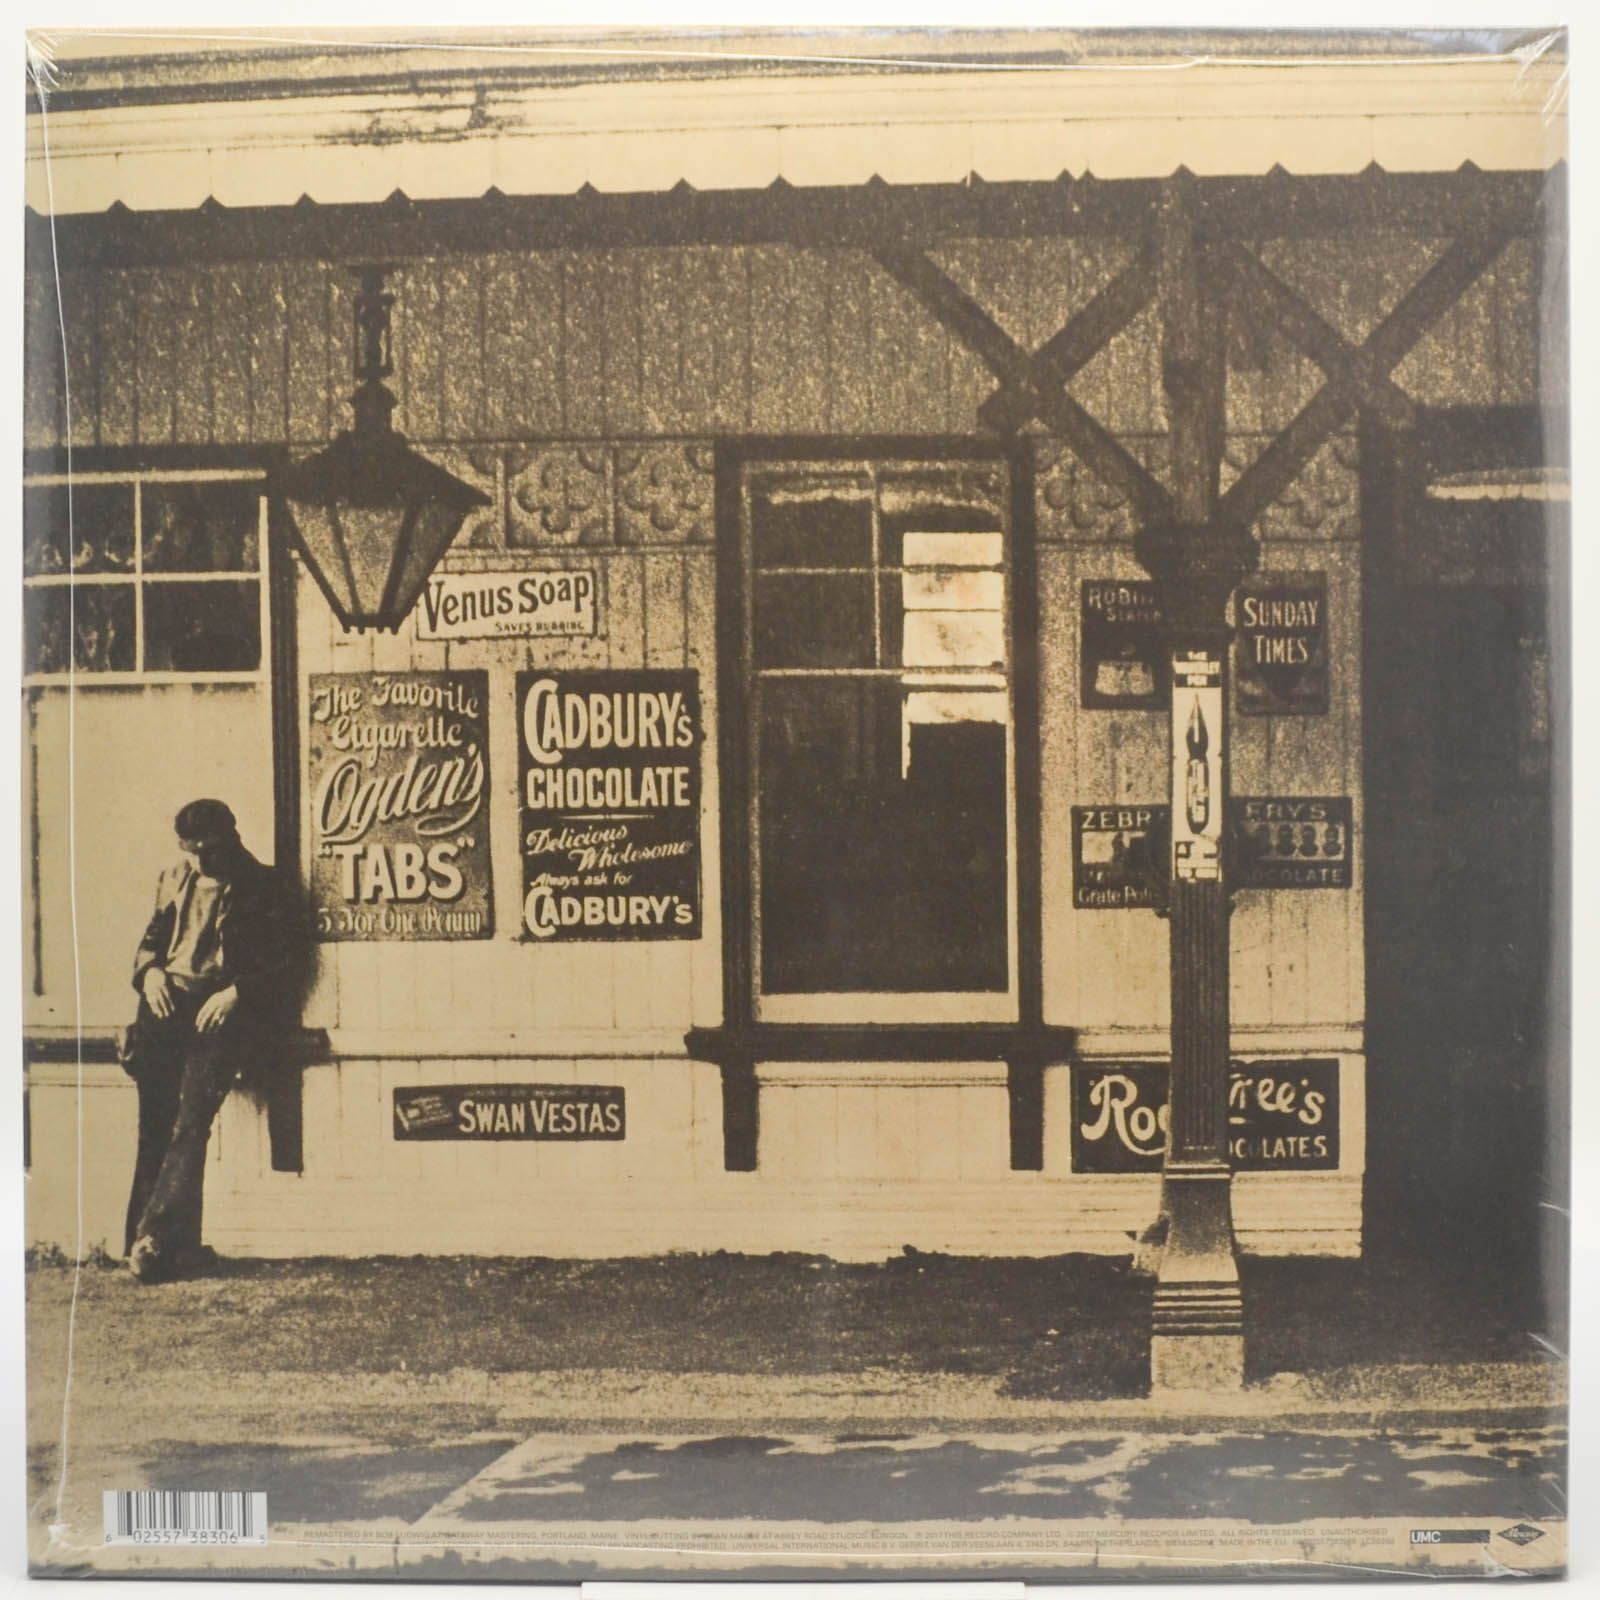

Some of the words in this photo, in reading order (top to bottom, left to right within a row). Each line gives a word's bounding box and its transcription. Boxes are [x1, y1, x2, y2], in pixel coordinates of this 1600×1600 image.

[425, 577, 513, 632] Venus
[518, 574, 591, 614] Soap
[1243, 597, 1318, 628] SUNDAY
[1255, 635, 1309, 664] TIMES
[314, 684, 362, 720] The
[331, 716, 463, 767] Cigarette
[320, 743, 485, 844] Ogden's
[526, 767, 691, 809] CHOCOLATE
[1081, 811, 1152, 829] ZEBR
[526, 825, 628, 856] Delicious
[568, 842, 693, 872] Wholesome
[530, 872, 579, 889] Always
[583, 873, 608, 886] ask
[613, 872, 632, 886] for
[458, 1099, 526, 1133] SWAN
[531, 1099, 622, 1133] VESTAS
[133, 1530, 181, 1544] 02557
[189, 1530, 238, 1545] 38306
[1411, 1530, 1441, 1544] UMC
